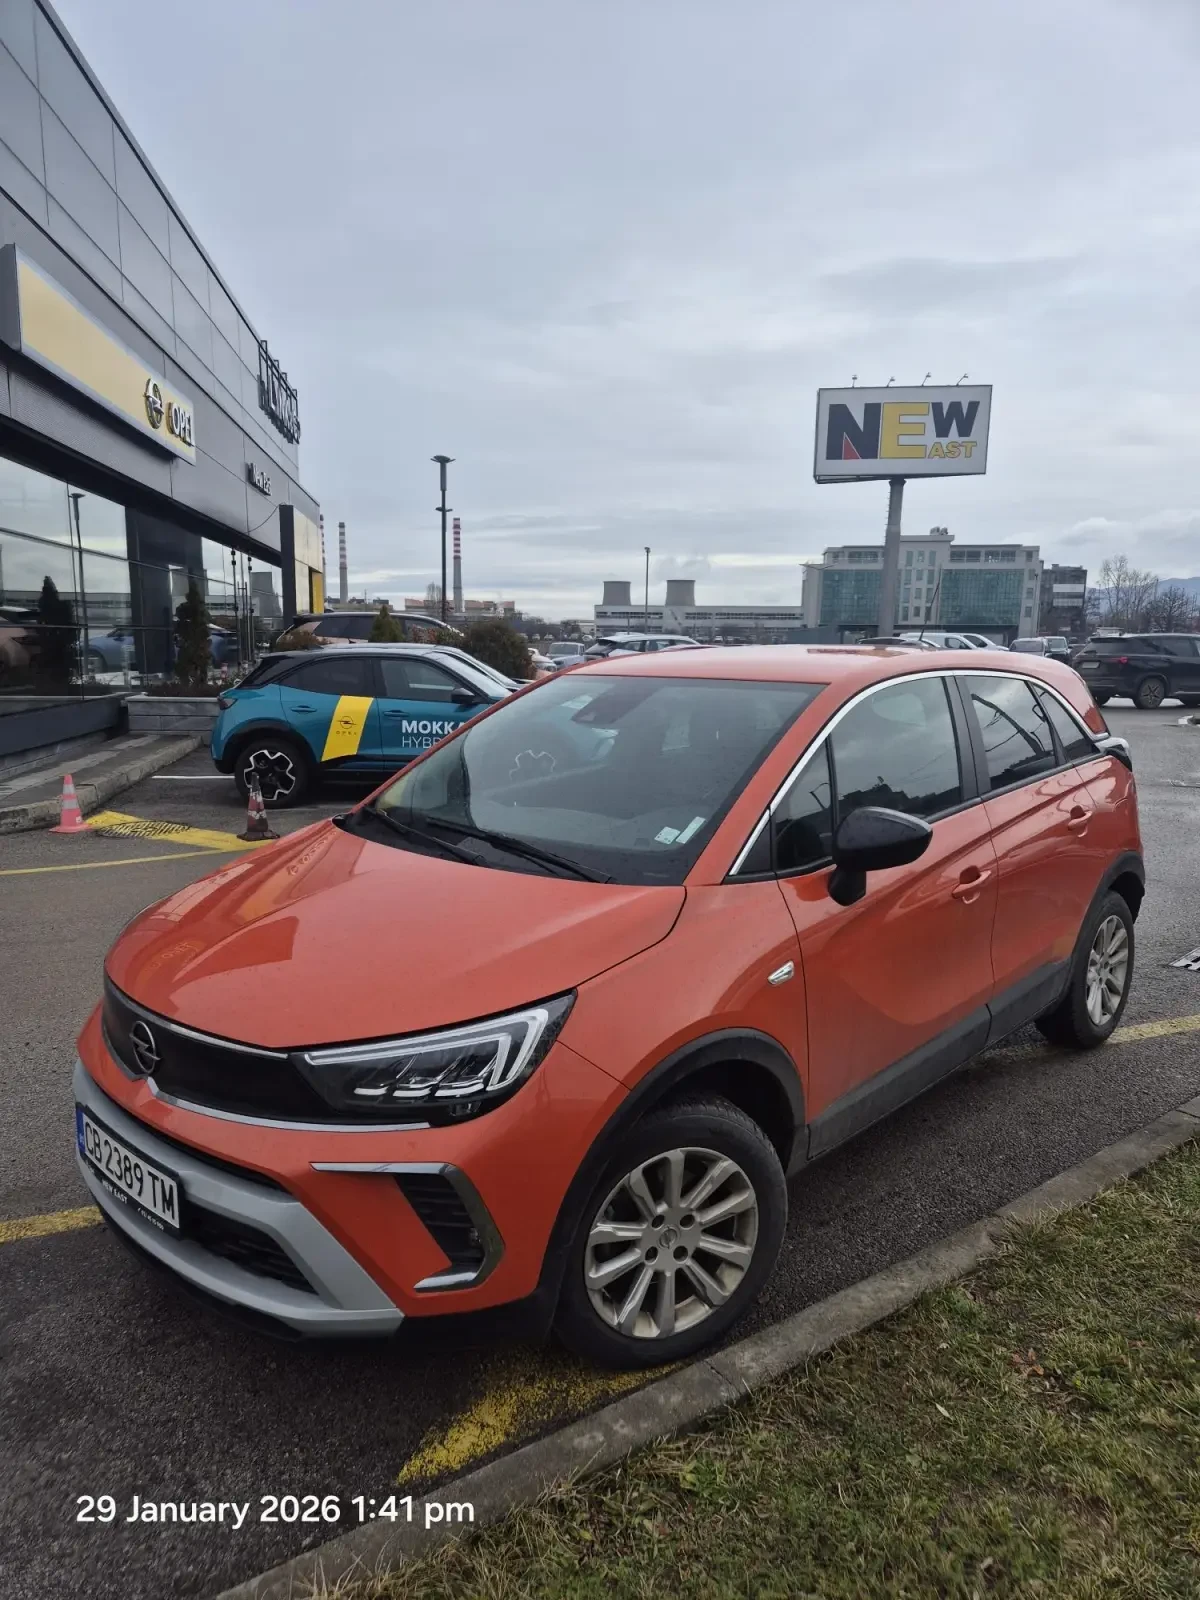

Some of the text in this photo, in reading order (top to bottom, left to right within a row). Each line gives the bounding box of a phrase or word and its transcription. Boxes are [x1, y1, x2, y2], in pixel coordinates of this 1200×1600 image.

[826, 401, 980, 460] NEW
[85, 1121, 102, 1164] CB
[104, 1139, 144, 1198] 2389
[147, 1170, 175, 1221] TM
